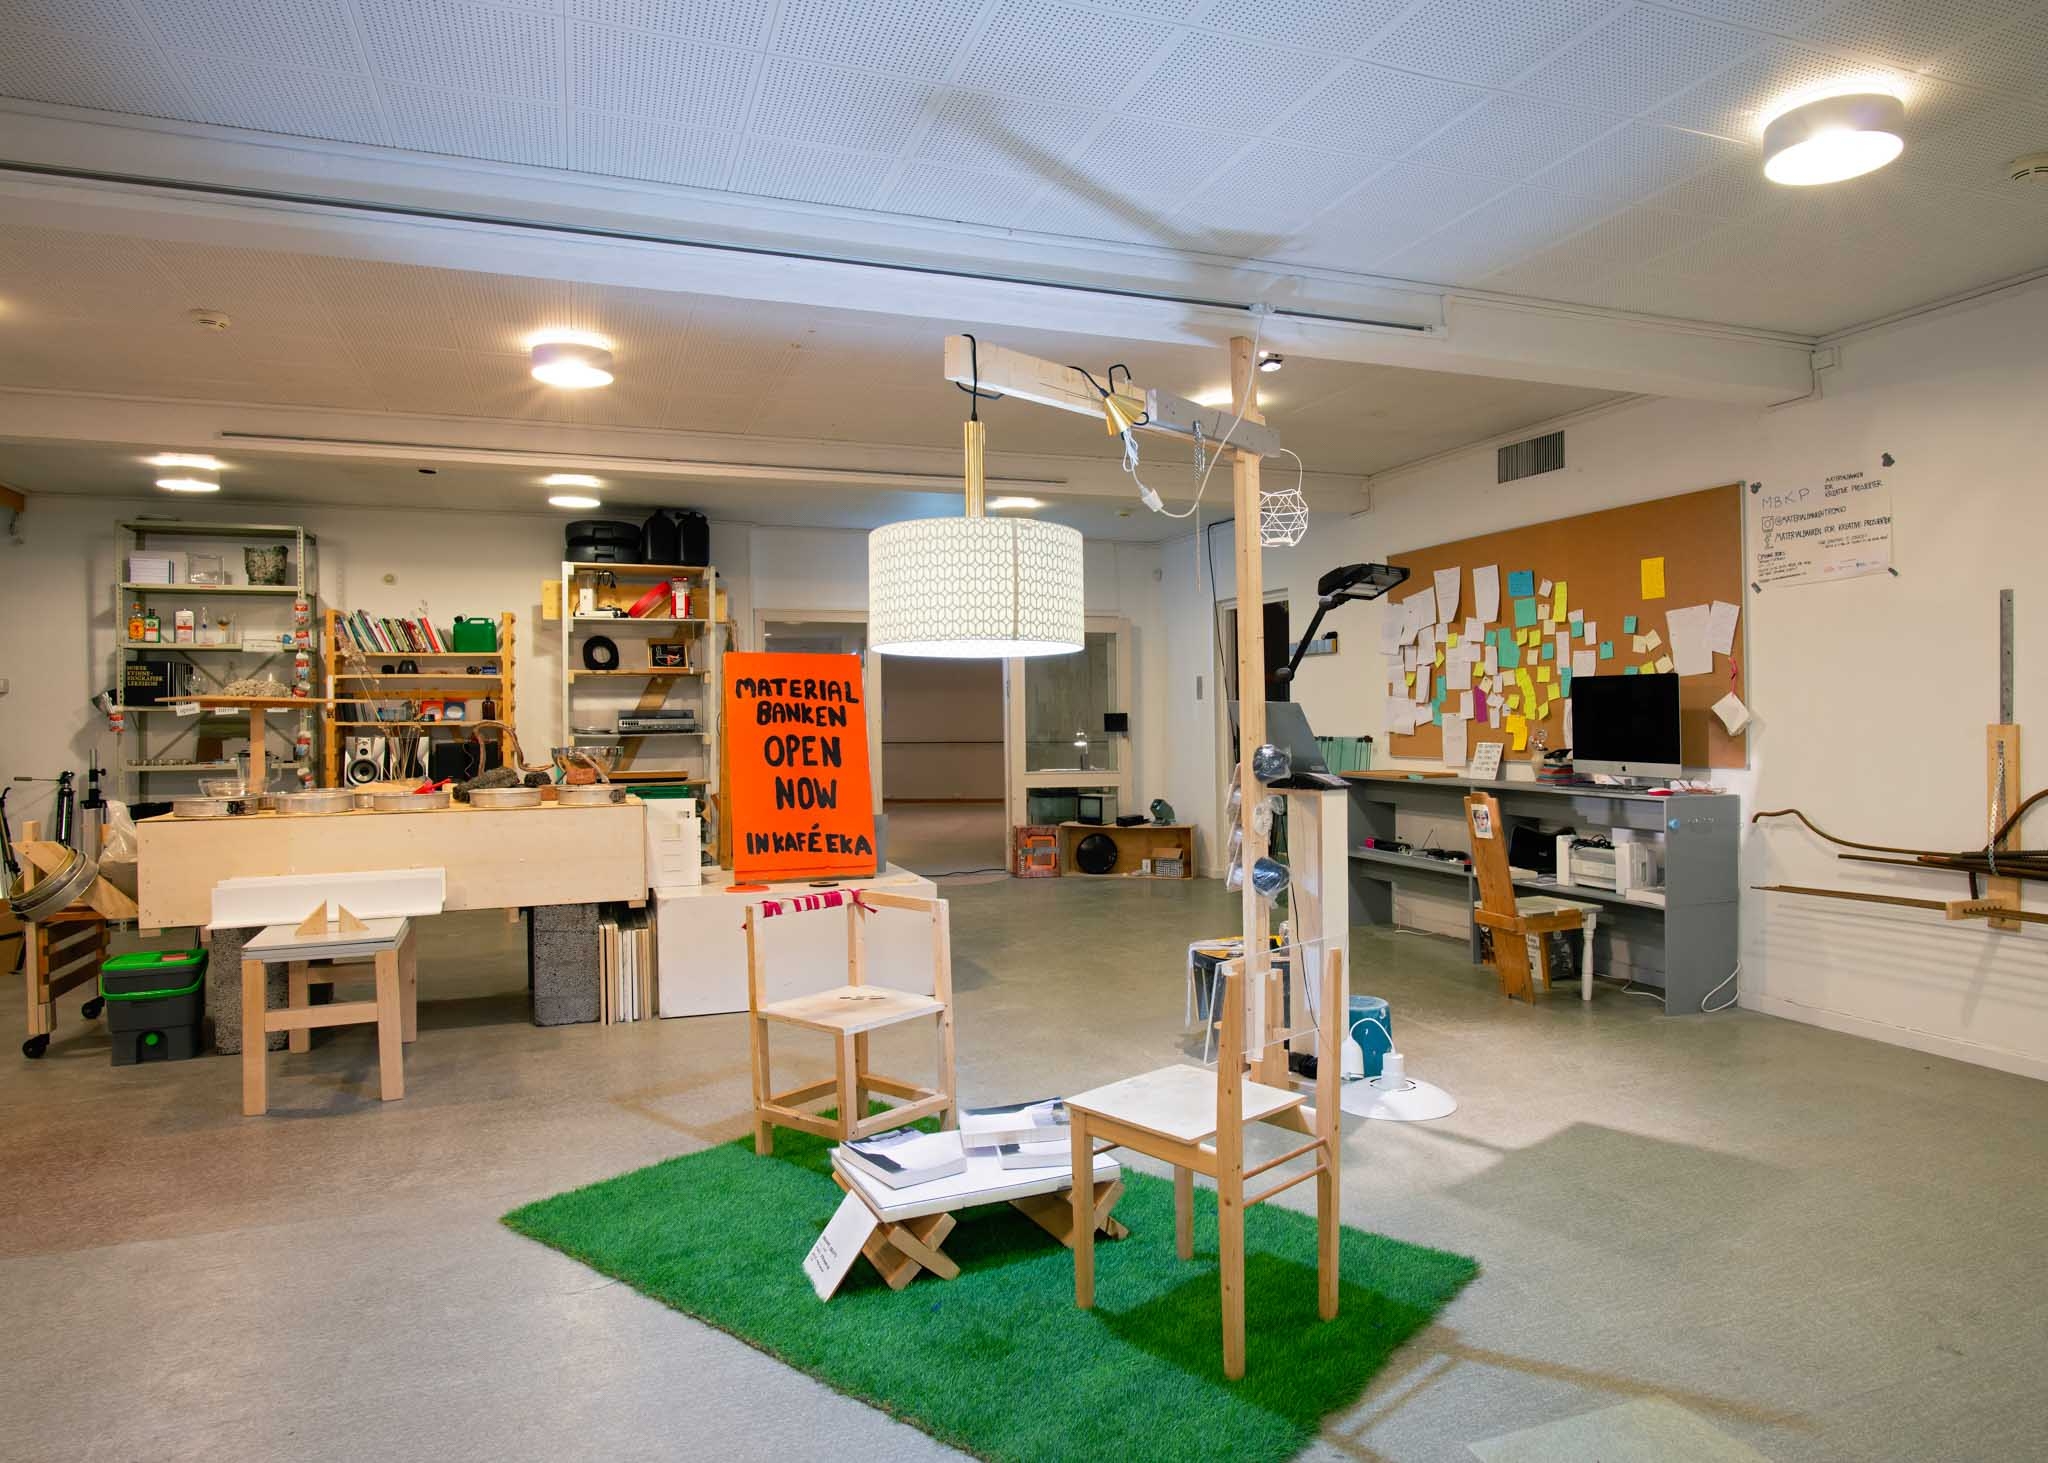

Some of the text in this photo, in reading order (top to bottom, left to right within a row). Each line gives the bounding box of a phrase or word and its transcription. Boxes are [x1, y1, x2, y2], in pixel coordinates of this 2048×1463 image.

[735, 677, 860, 704] MATERIAL
[756, 700, 847, 727] BANKEN
[764, 734, 842, 768] OPEN
[775, 776, 837, 810] NOW
[746, 823, 873, 856] IN KAFÉ EKA
